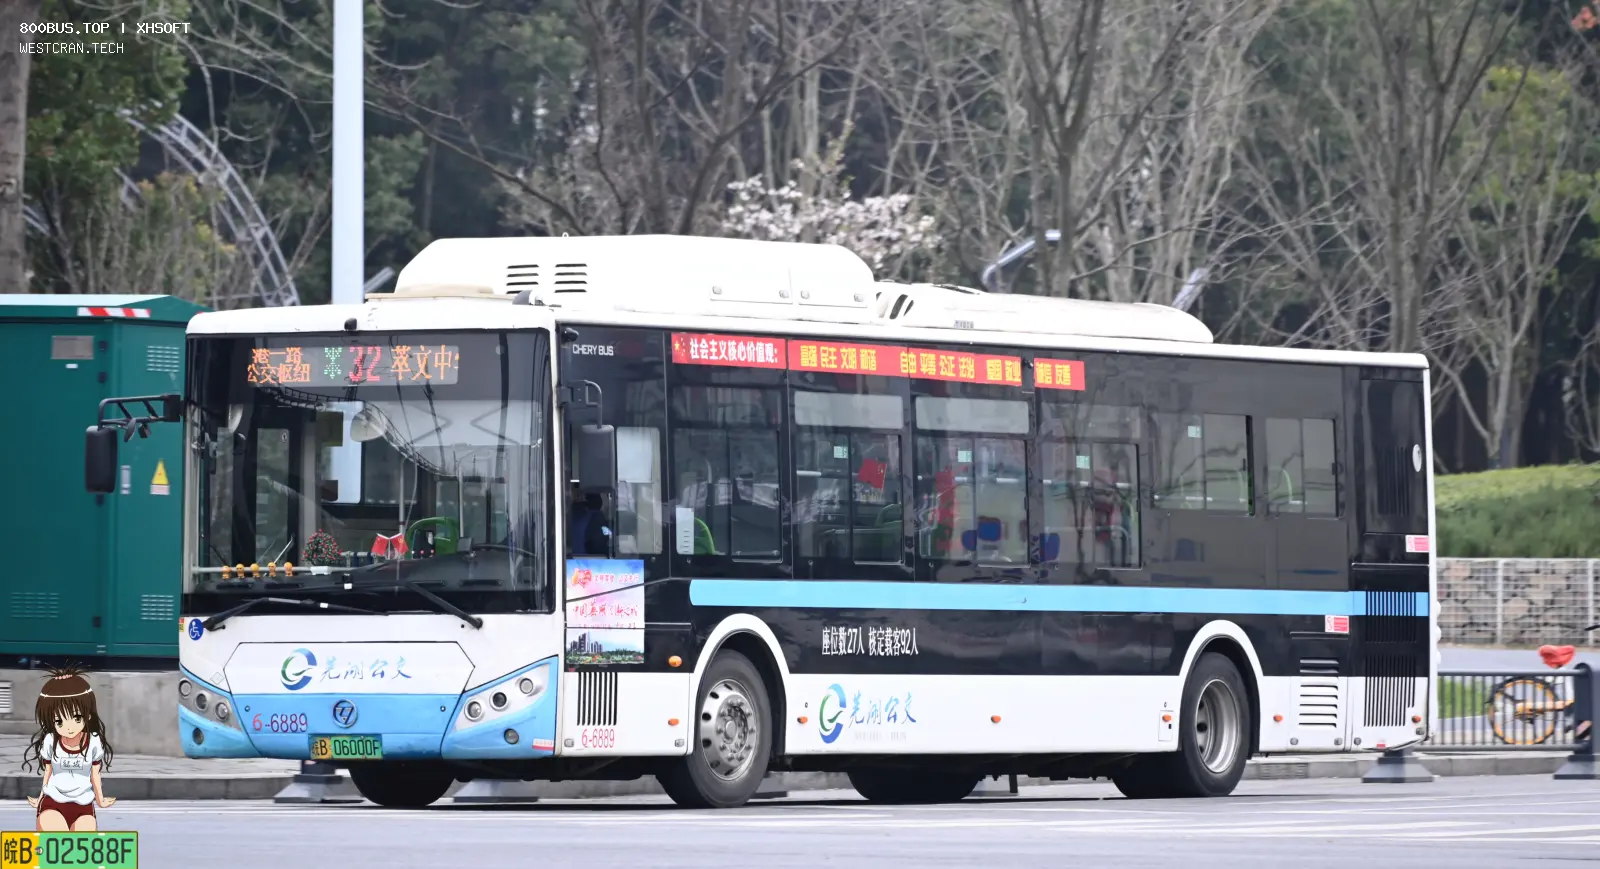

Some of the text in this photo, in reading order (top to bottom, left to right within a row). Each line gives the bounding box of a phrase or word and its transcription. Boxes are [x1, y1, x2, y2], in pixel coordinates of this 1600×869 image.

[252, 347, 303, 364] 港一路
[572, 344, 614, 356] CHERY BUS
[247, 363, 311, 384] 公交枢纽
[348, 346, 382, 382] 32
[390, 344, 460, 381] 萃文中
[800, 345, 1072, 386] 富强 民主 文明 和谐 自由 平等 公正 法治 爱国 敬业 诚信 友善
[821, 626, 919, 657] 座位数27人 核定载客92人
[320, 655, 412, 683] 芜湖公交
[848, 689, 917, 729] 芜湖公交
[252, 712, 308, 733] 6-6889
[333, 739, 380, 757] 06000F
[581, 728, 615, 749] 6-6889
